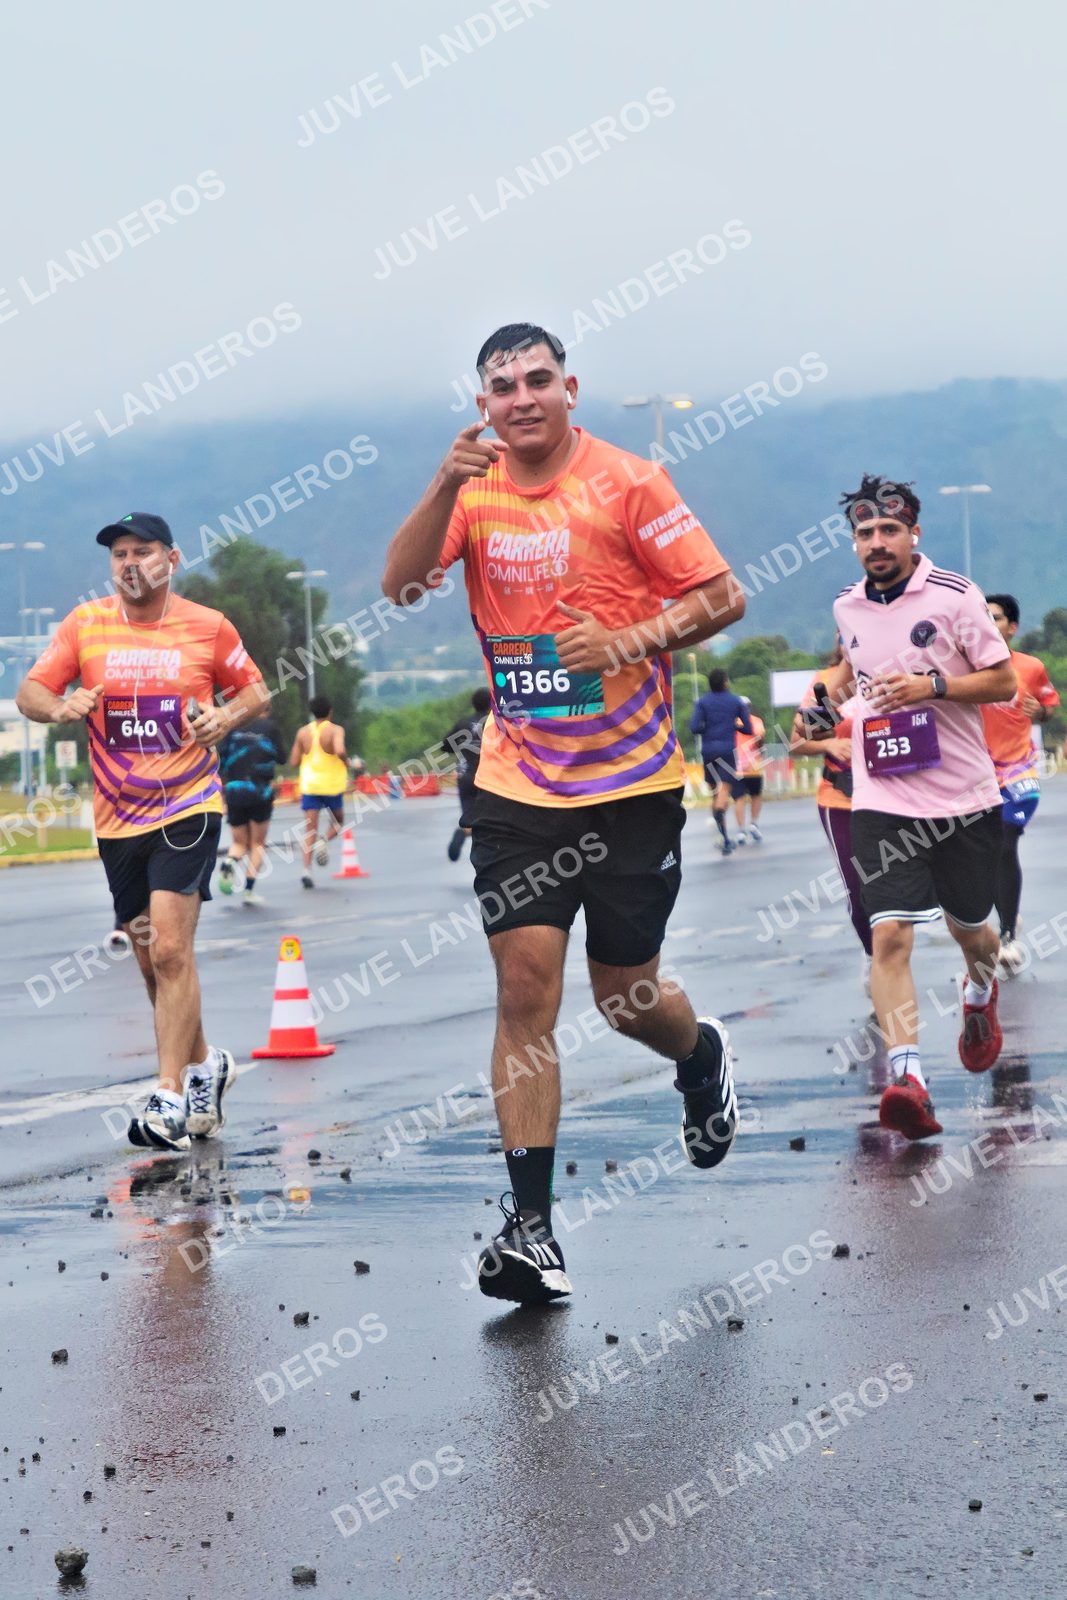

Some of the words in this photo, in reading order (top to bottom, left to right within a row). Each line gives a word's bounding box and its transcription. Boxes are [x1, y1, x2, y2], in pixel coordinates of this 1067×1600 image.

[487, 529, 570, 561] CARRERA
[106, 649, 181, 667] CARRERA
[493, 642, 532, 655] CARRERA
[506, 668, 570, 694] 1366
[122, 720, 158, 737] 640
[877, 736, 911, 758] 253
